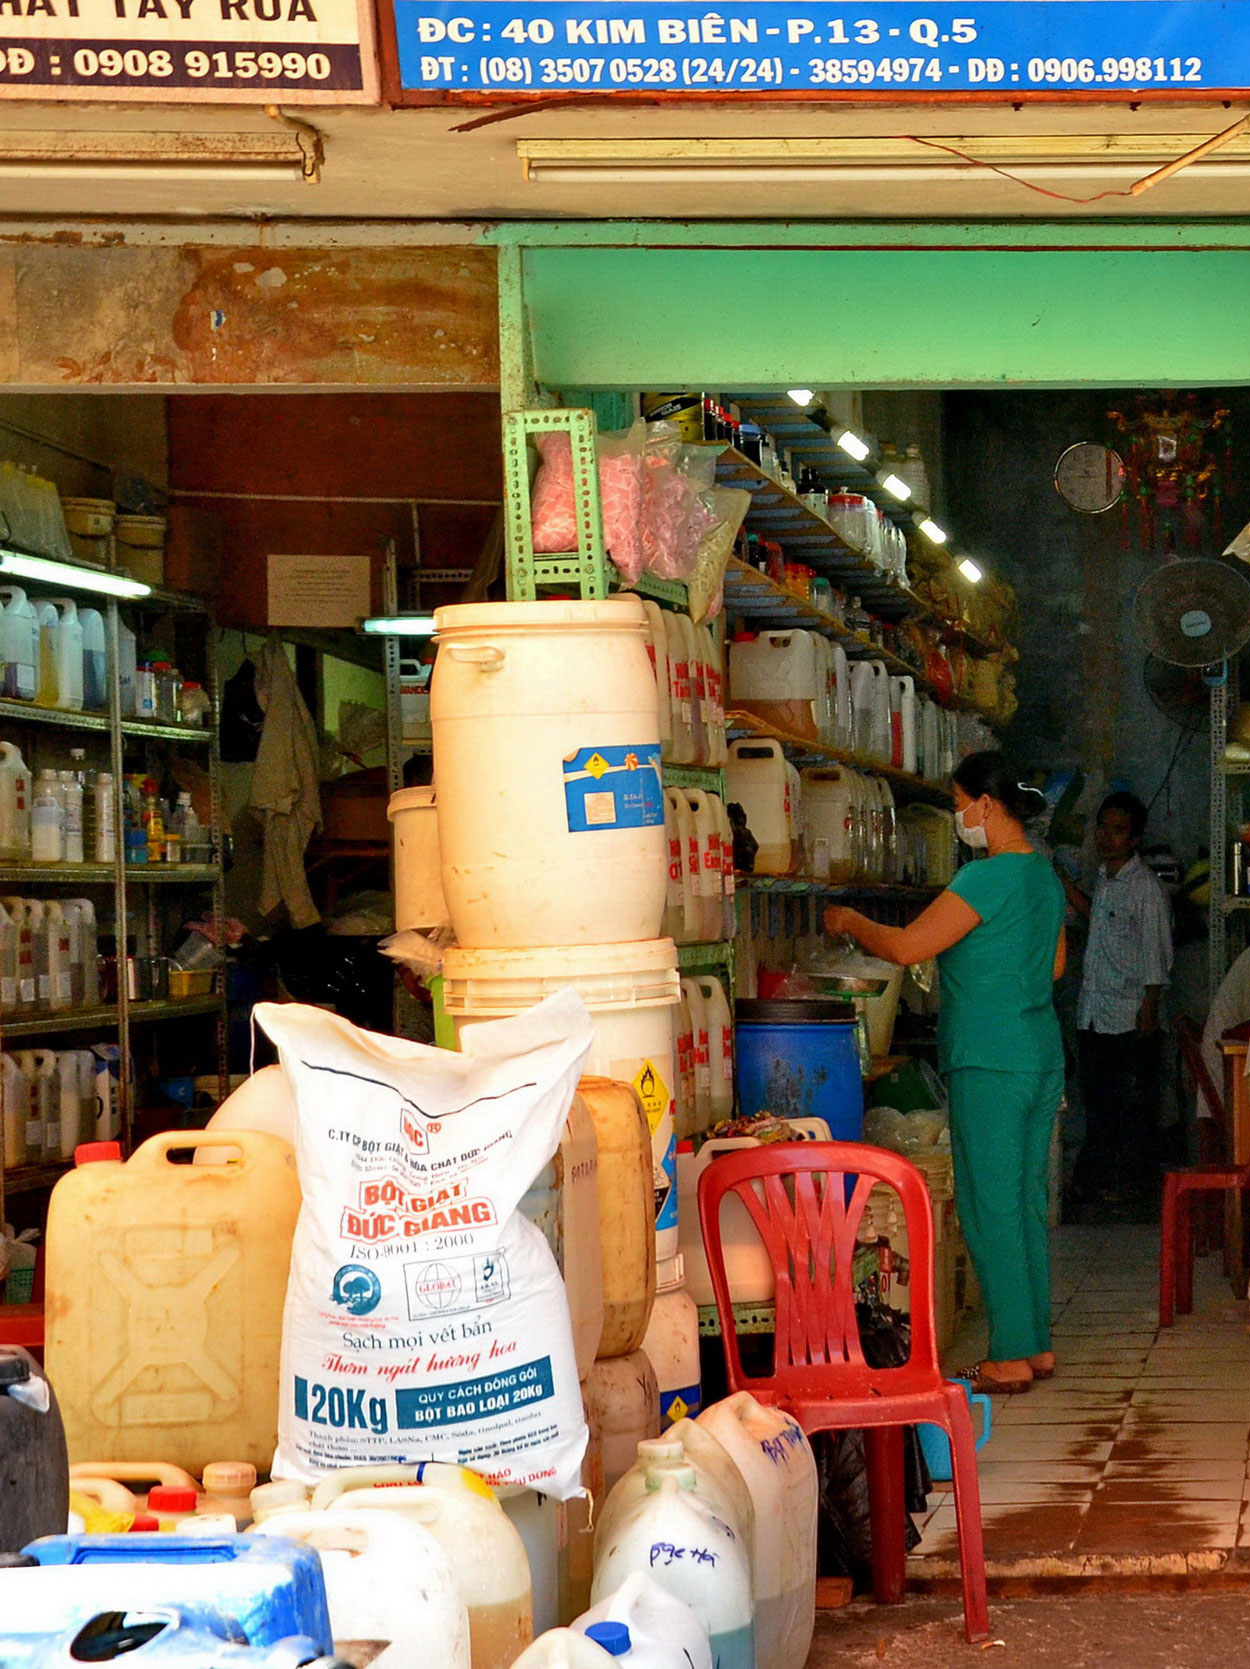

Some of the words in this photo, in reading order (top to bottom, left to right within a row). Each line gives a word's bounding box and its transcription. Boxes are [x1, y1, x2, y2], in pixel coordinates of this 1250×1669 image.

[417, 17, 475, 44] ĐC
[501, 18, 555, 44] 40
[566, 18, 646, 44] KIM
[657, 12, 758, 44] BIÊN
[787, 18, 880, 44] P.13
[909, 18, 978, 48] Q.5
[73, 48, 174, 78] 0908
[184, 50, 331, 80] 915990
[420, 56, 455, 82] ĐT
[479, 56, 532, 85] (08)
[540, 58, 603, 83] 3507
[609, 58, 677, 83] 0528
[682, 57, 784, 85] (24/24)
[808, 57, 941, 84] 38594974
[1028, 57, 1201, 83] 0906.998112
[403, 1202, 491, 1237] GIANG
[435, 1233, 474, 1250] 2000
[418, 1280, 457, 1294] GLOBAL
[389, 1331, 423, 1351] mọi
[311, 1383, 389, 1435] 20Kg
[414, 1406, 442, 1423] BỘT
[447, 1402, 475, 1418] BAO
[480, 1393, 510, 1411] LOẠI
[513, 1384, 543, 1403] 20Kg
[418, 1392, 445, 1404] QUY
